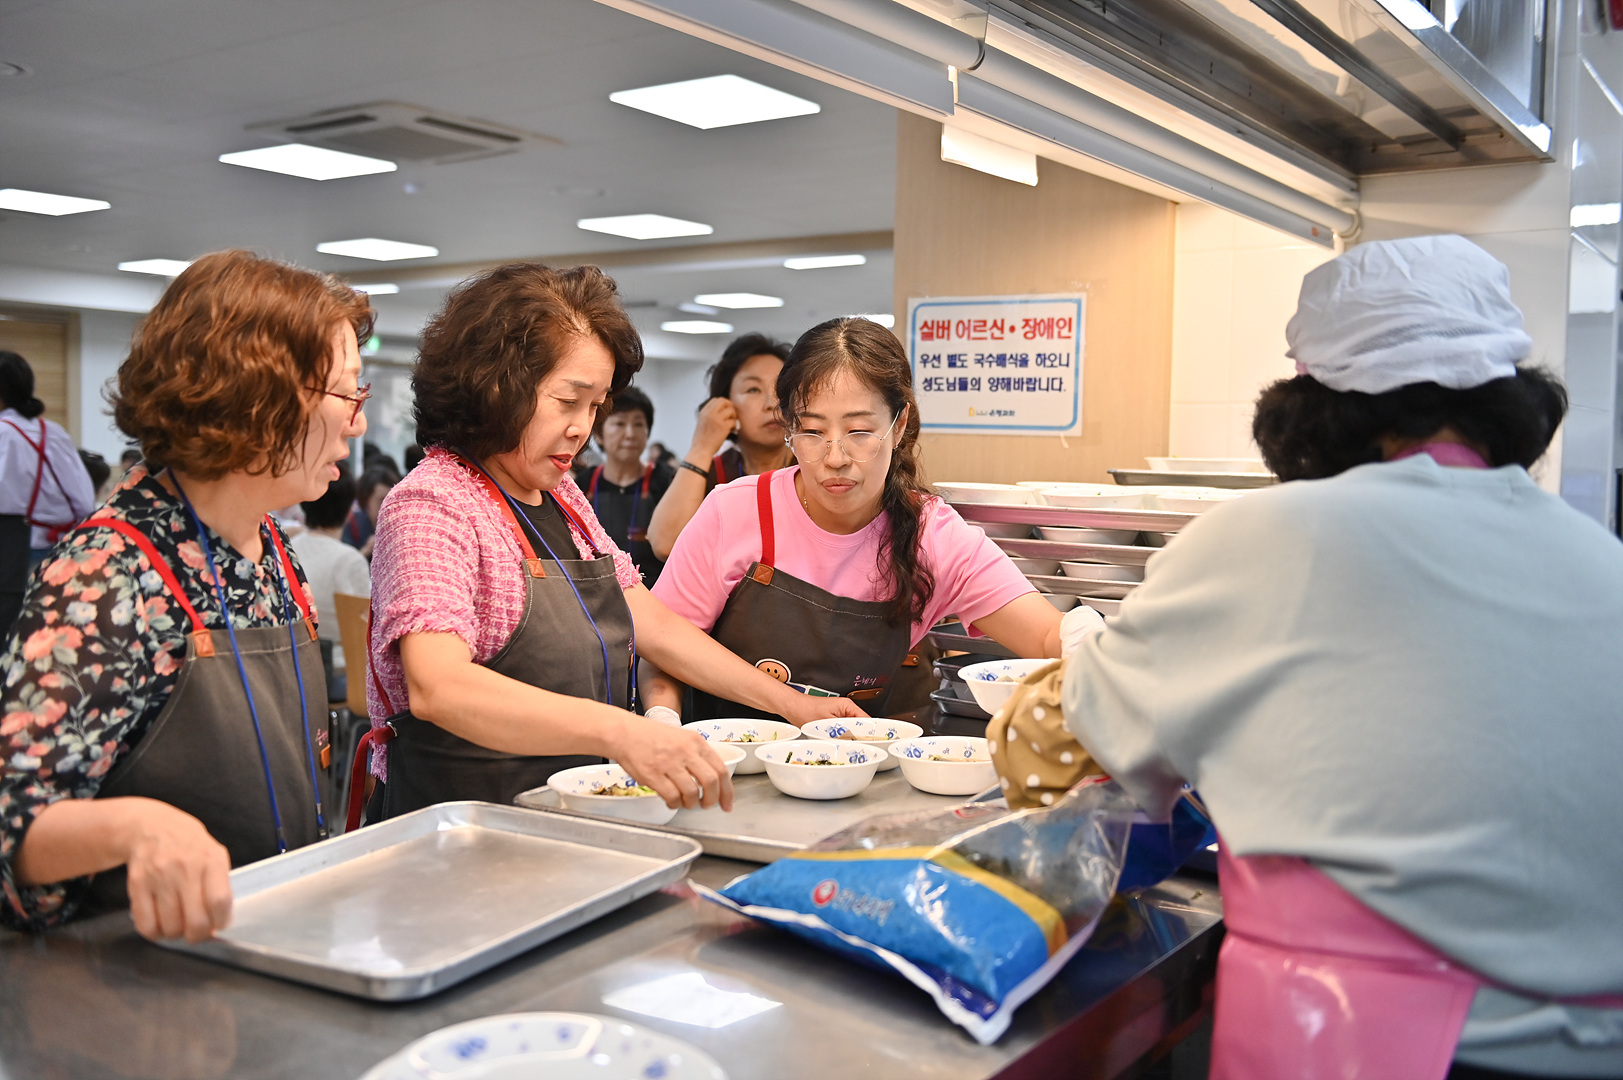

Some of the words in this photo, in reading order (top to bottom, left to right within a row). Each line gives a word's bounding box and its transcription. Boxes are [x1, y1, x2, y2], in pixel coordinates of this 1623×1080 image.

[919, 319, 951, 341] 실버
[1021, 317, 1073, 340] 장애인
[919, 353, 941, 368] 우선
[947, 353, 968, 368] 별도
[974, 353, 1029, 368] 국수배식을
[1035, 352, 1070, 368] 하오니
[922, 377, 981, 392] 성도님들의
[988, 377, 1066, 393] 양해바랍니다.
